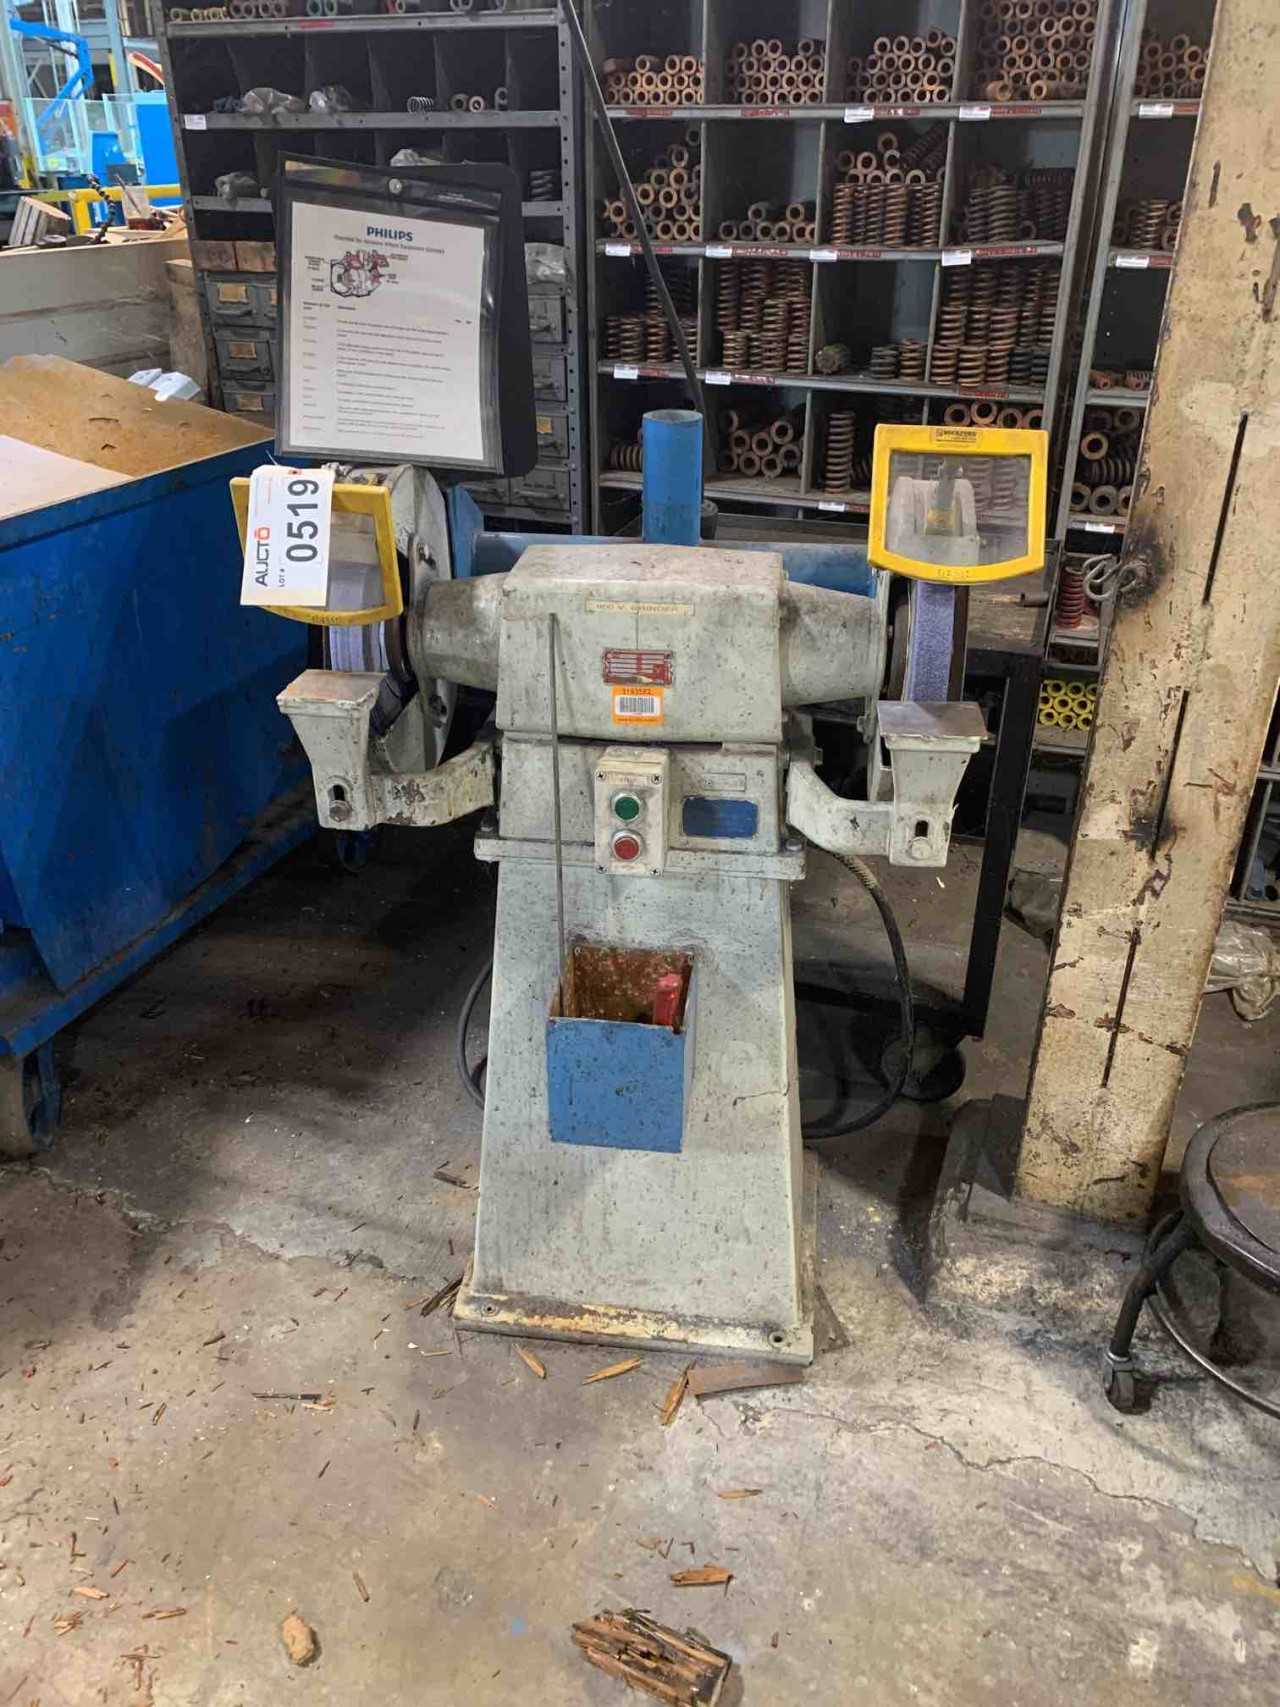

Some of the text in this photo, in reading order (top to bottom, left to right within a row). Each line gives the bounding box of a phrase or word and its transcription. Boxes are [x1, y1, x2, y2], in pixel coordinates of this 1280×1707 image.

[366, 226, 413, 242] PHILIPS
[285, 479, 320, 563] 0519
[254, 526, 271, 587] AUCTO
